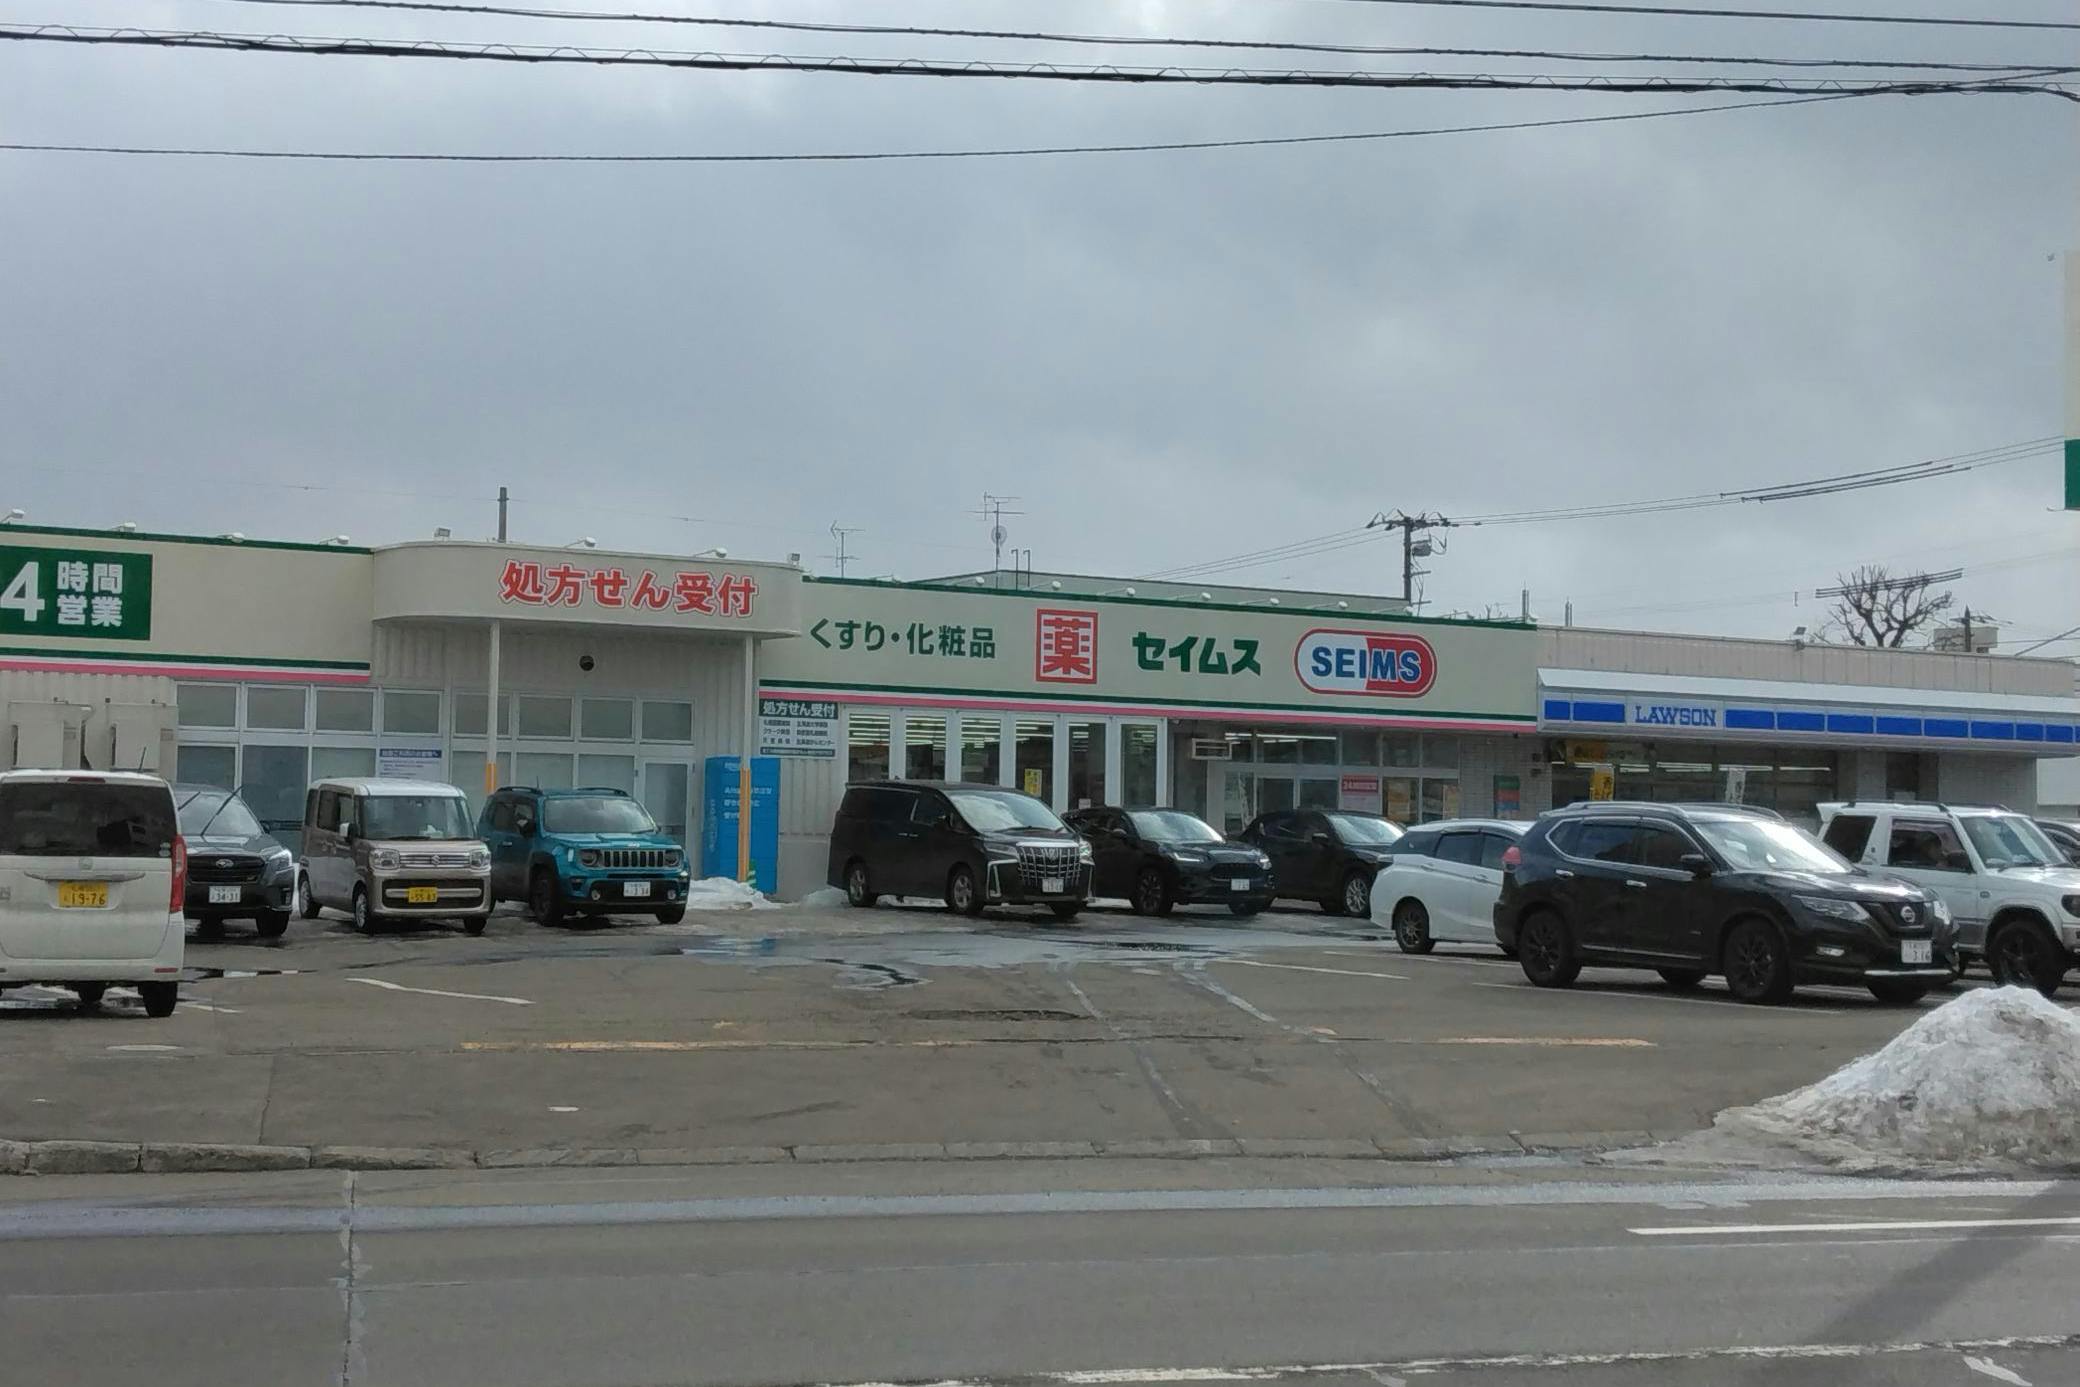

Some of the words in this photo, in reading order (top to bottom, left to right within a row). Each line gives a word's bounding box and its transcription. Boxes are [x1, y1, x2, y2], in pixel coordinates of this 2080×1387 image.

[57, 561, 123, 594] 時間
[499, 560, 757, 616] 処方せん受付
[57, 595, 122, 627] 営業
[810, 618, 996, 659] くすり・化粧品
[1042, 616, 1092, 676] 薬
[1132, 631, 1261, 677] セイムス
[1311, 646, 1422, 683] SEIMS
[763, 701, 836, 717] 処方せん受付
[1635, 705, 1717, 727] LAWSON
